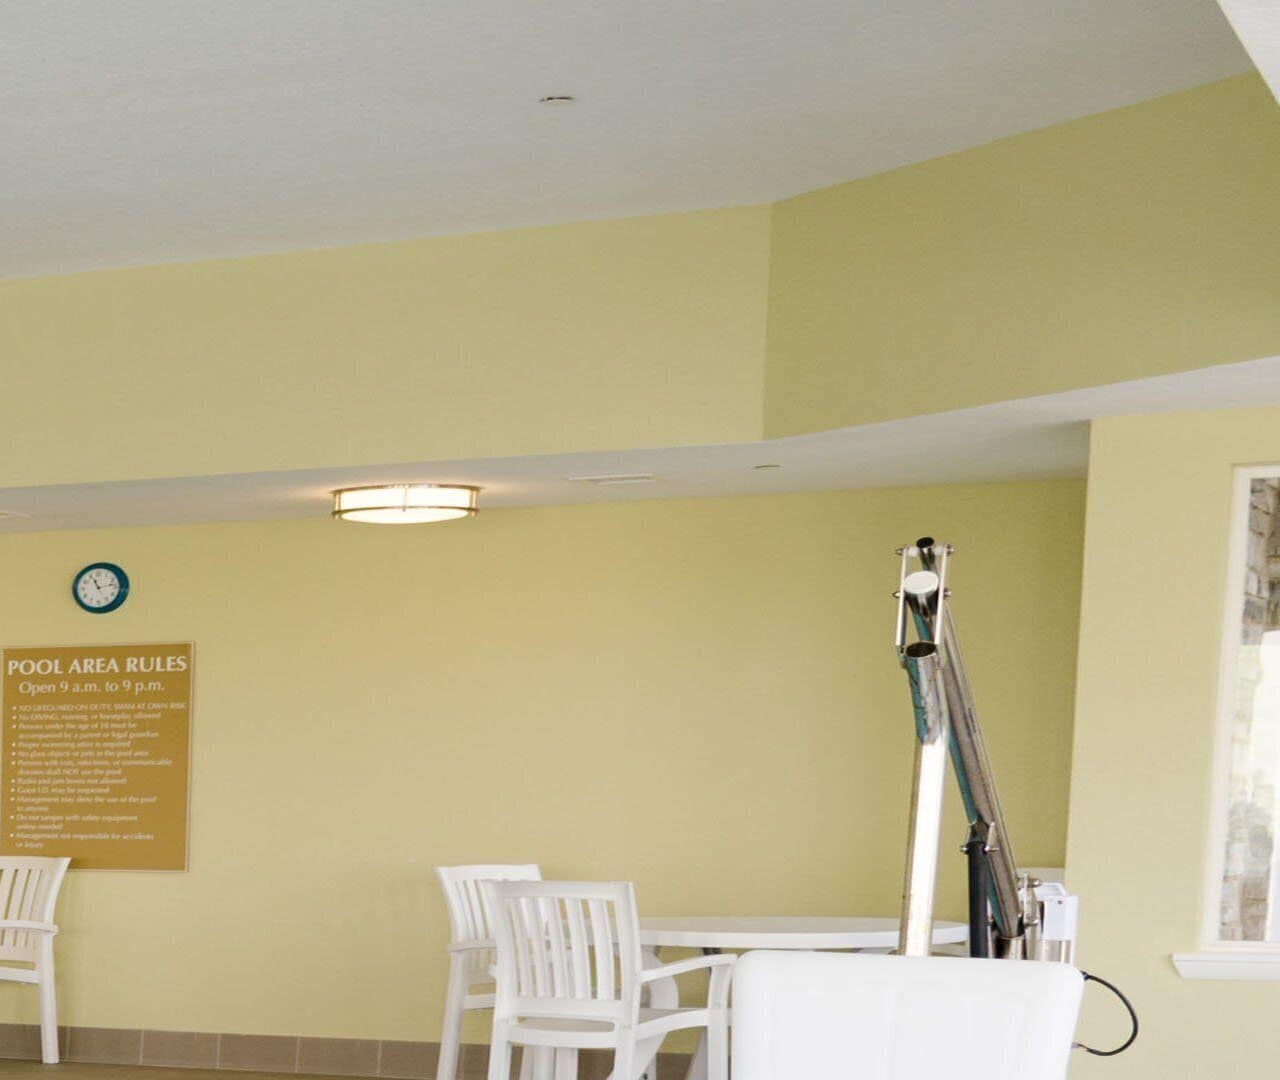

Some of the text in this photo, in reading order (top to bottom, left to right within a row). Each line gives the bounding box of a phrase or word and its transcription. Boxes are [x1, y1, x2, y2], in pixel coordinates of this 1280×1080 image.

[8, 655, 187, 676] POOL AREA RULES
[19, 680, 165, 697] Open 9 a.m. to 9 p.m.
